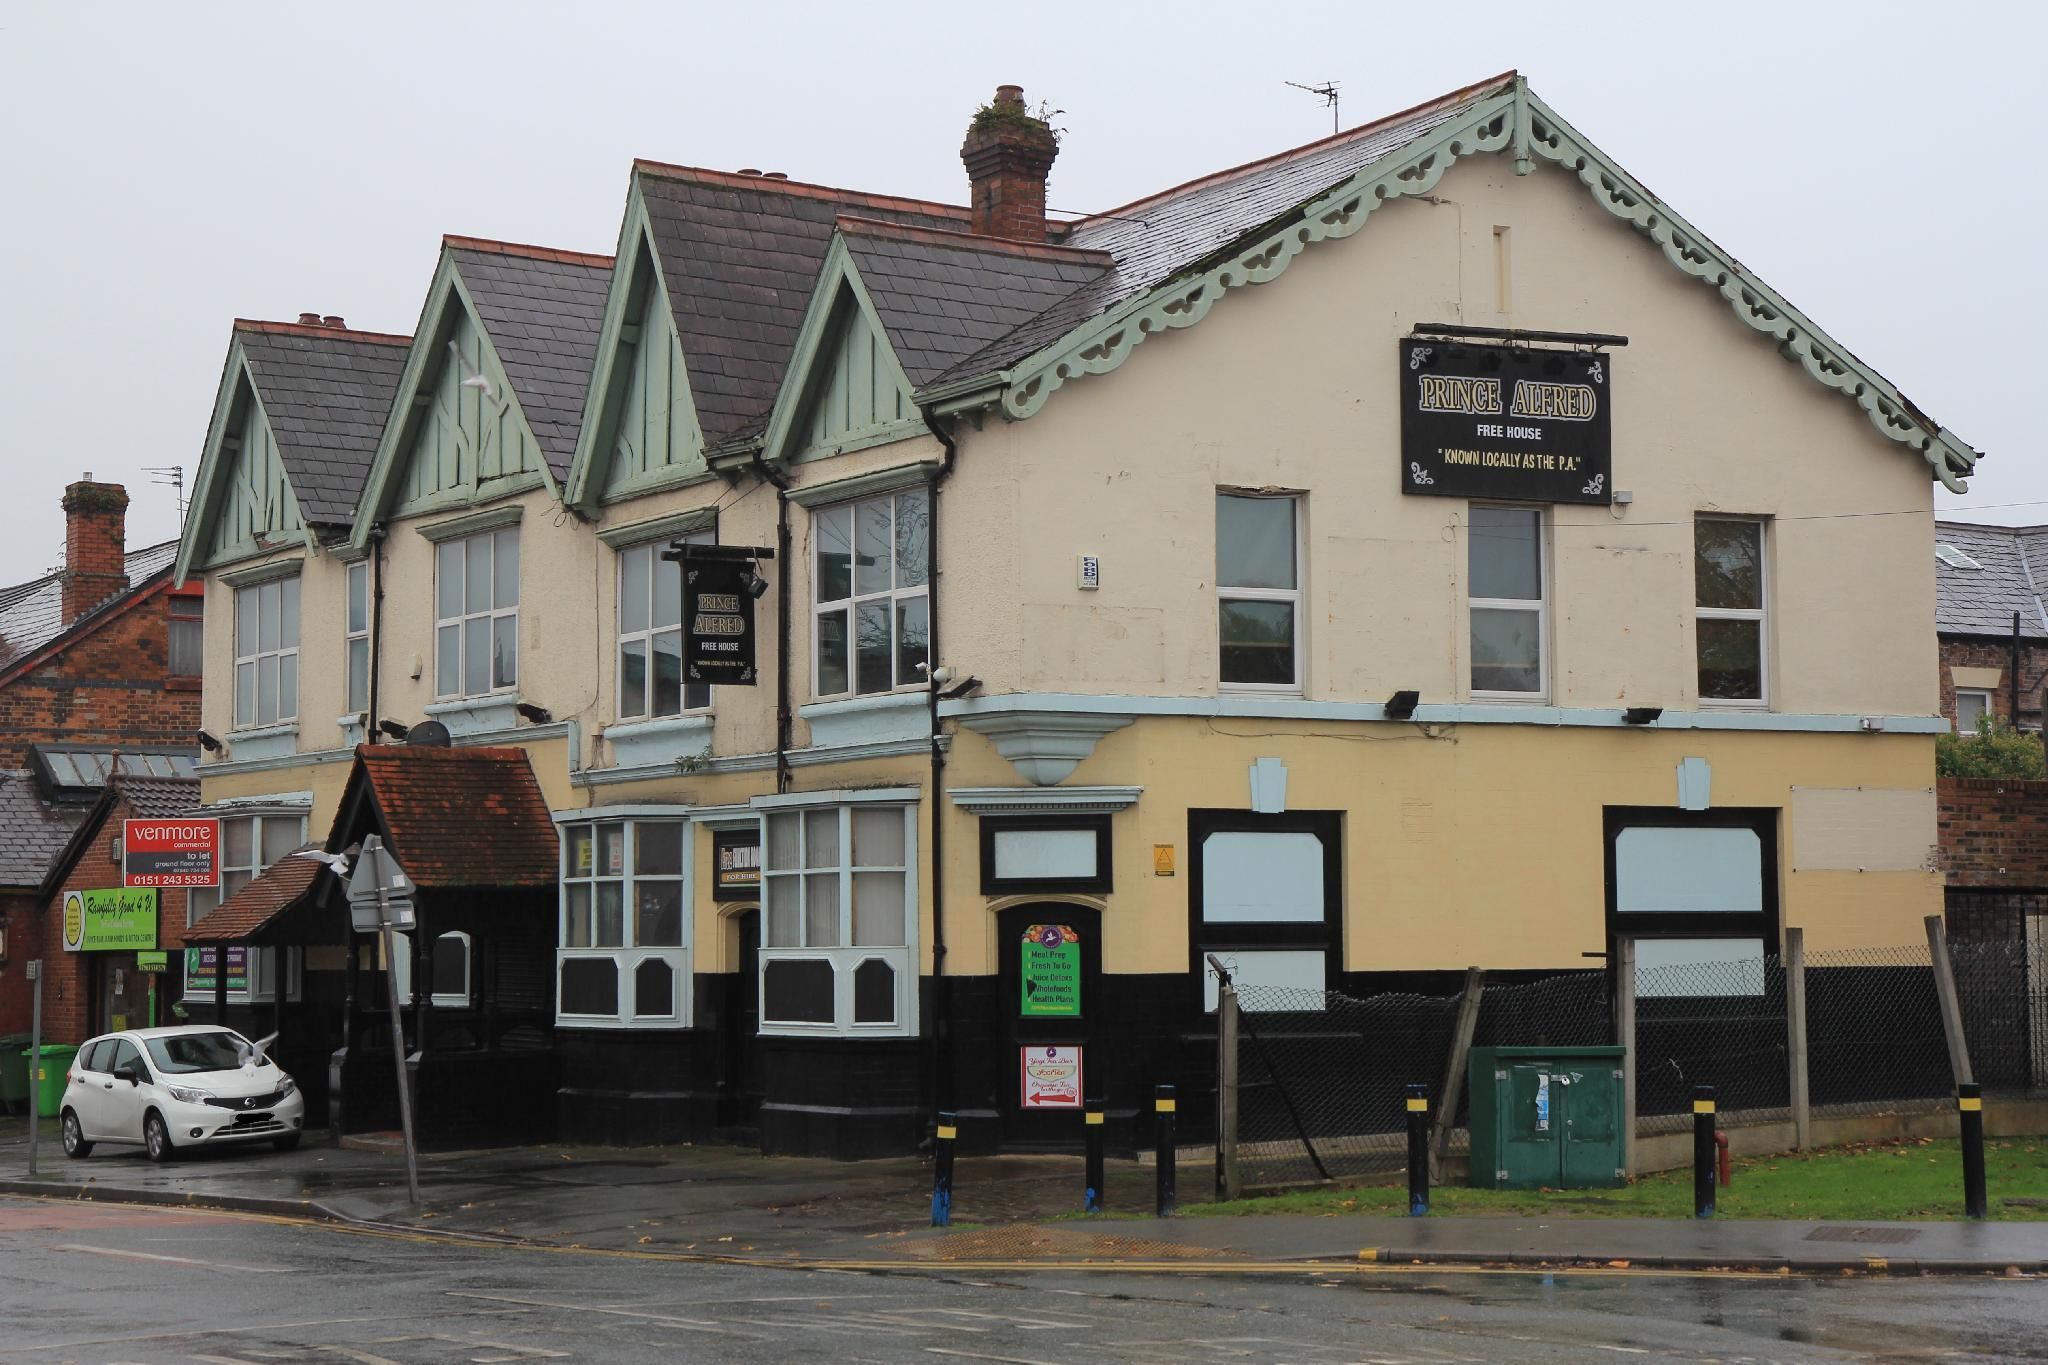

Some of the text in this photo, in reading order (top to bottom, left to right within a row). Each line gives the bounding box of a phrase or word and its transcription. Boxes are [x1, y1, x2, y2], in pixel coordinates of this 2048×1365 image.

[1420, 376, 1596, 421] PRINCE ALFRED
[1477, 424, 1542, 440] FREE HOUSE
[1482, 450, 1521, 468] LOCALLY
[1523, 455, 1535, 469] AS
[1536, 454, 1554, 470] THE
[698, 594, 739, 611] PRINCE
[694, 614, 744, 635] ALFRED
[701, 642, 739, 651] FREE HOUSE
[134, 826, 211, 841] venmore
[187, 852, 210, 860] to let
[196, 860, 211, 868] only
[134, 875, 210, 885] 0151 243 5325
[1050, 952, 1066, 960] Prep
[1032, 985, 1072, 993] Wholefoods
[1032, 995, 1054, 1003] Health
